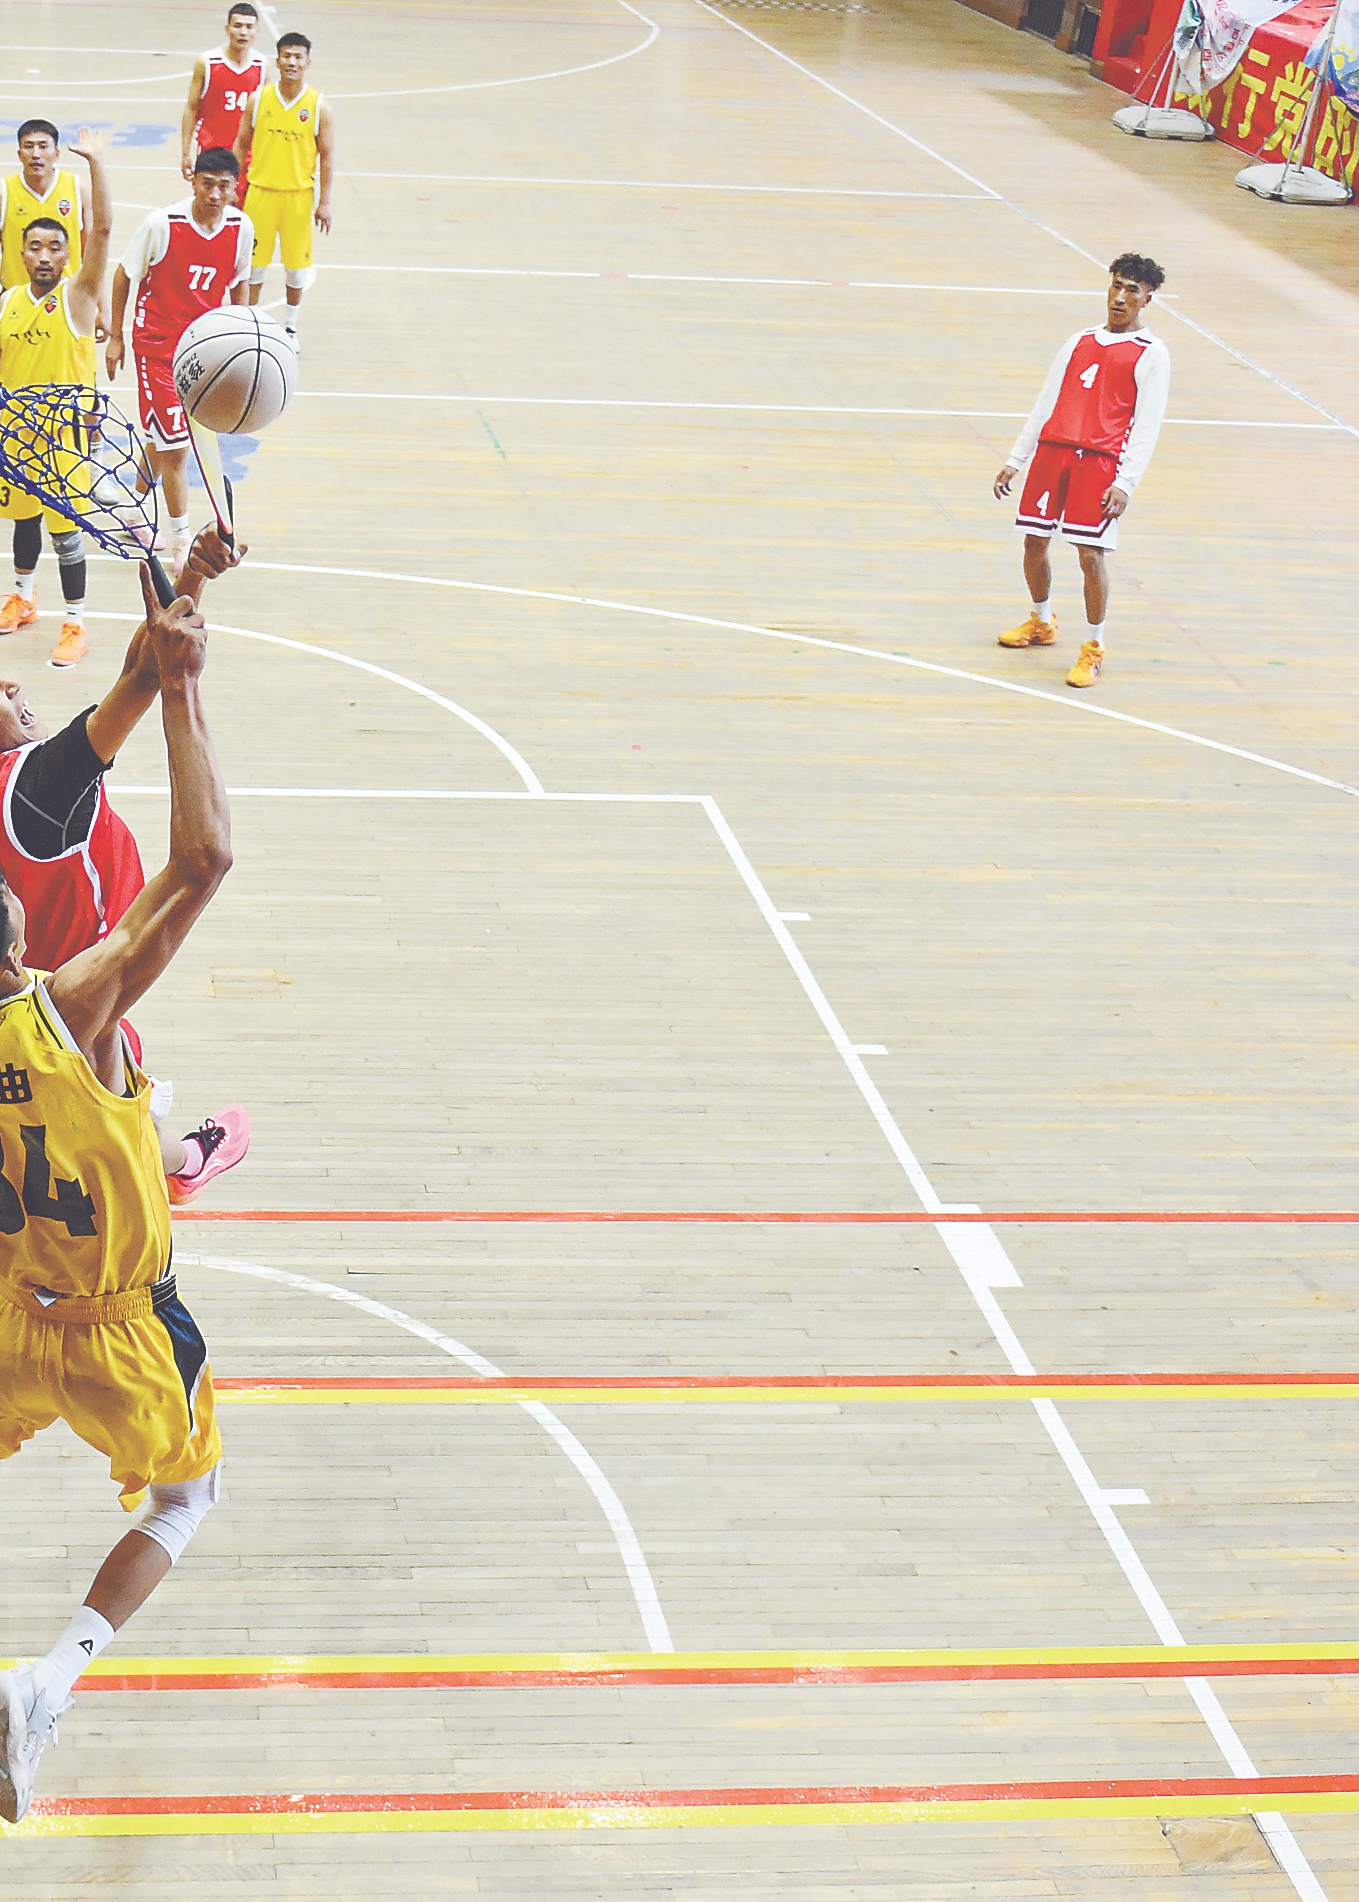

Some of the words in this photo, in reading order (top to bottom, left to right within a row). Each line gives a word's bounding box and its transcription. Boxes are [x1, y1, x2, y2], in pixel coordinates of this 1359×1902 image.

[224, 90, 248, 111] 34
[188, 264, 217, 291] 77
[1079, 363, 1100, 389] 4
[166, 405, 188, 432] 7
[1036, 490, 1050, 517] 4
